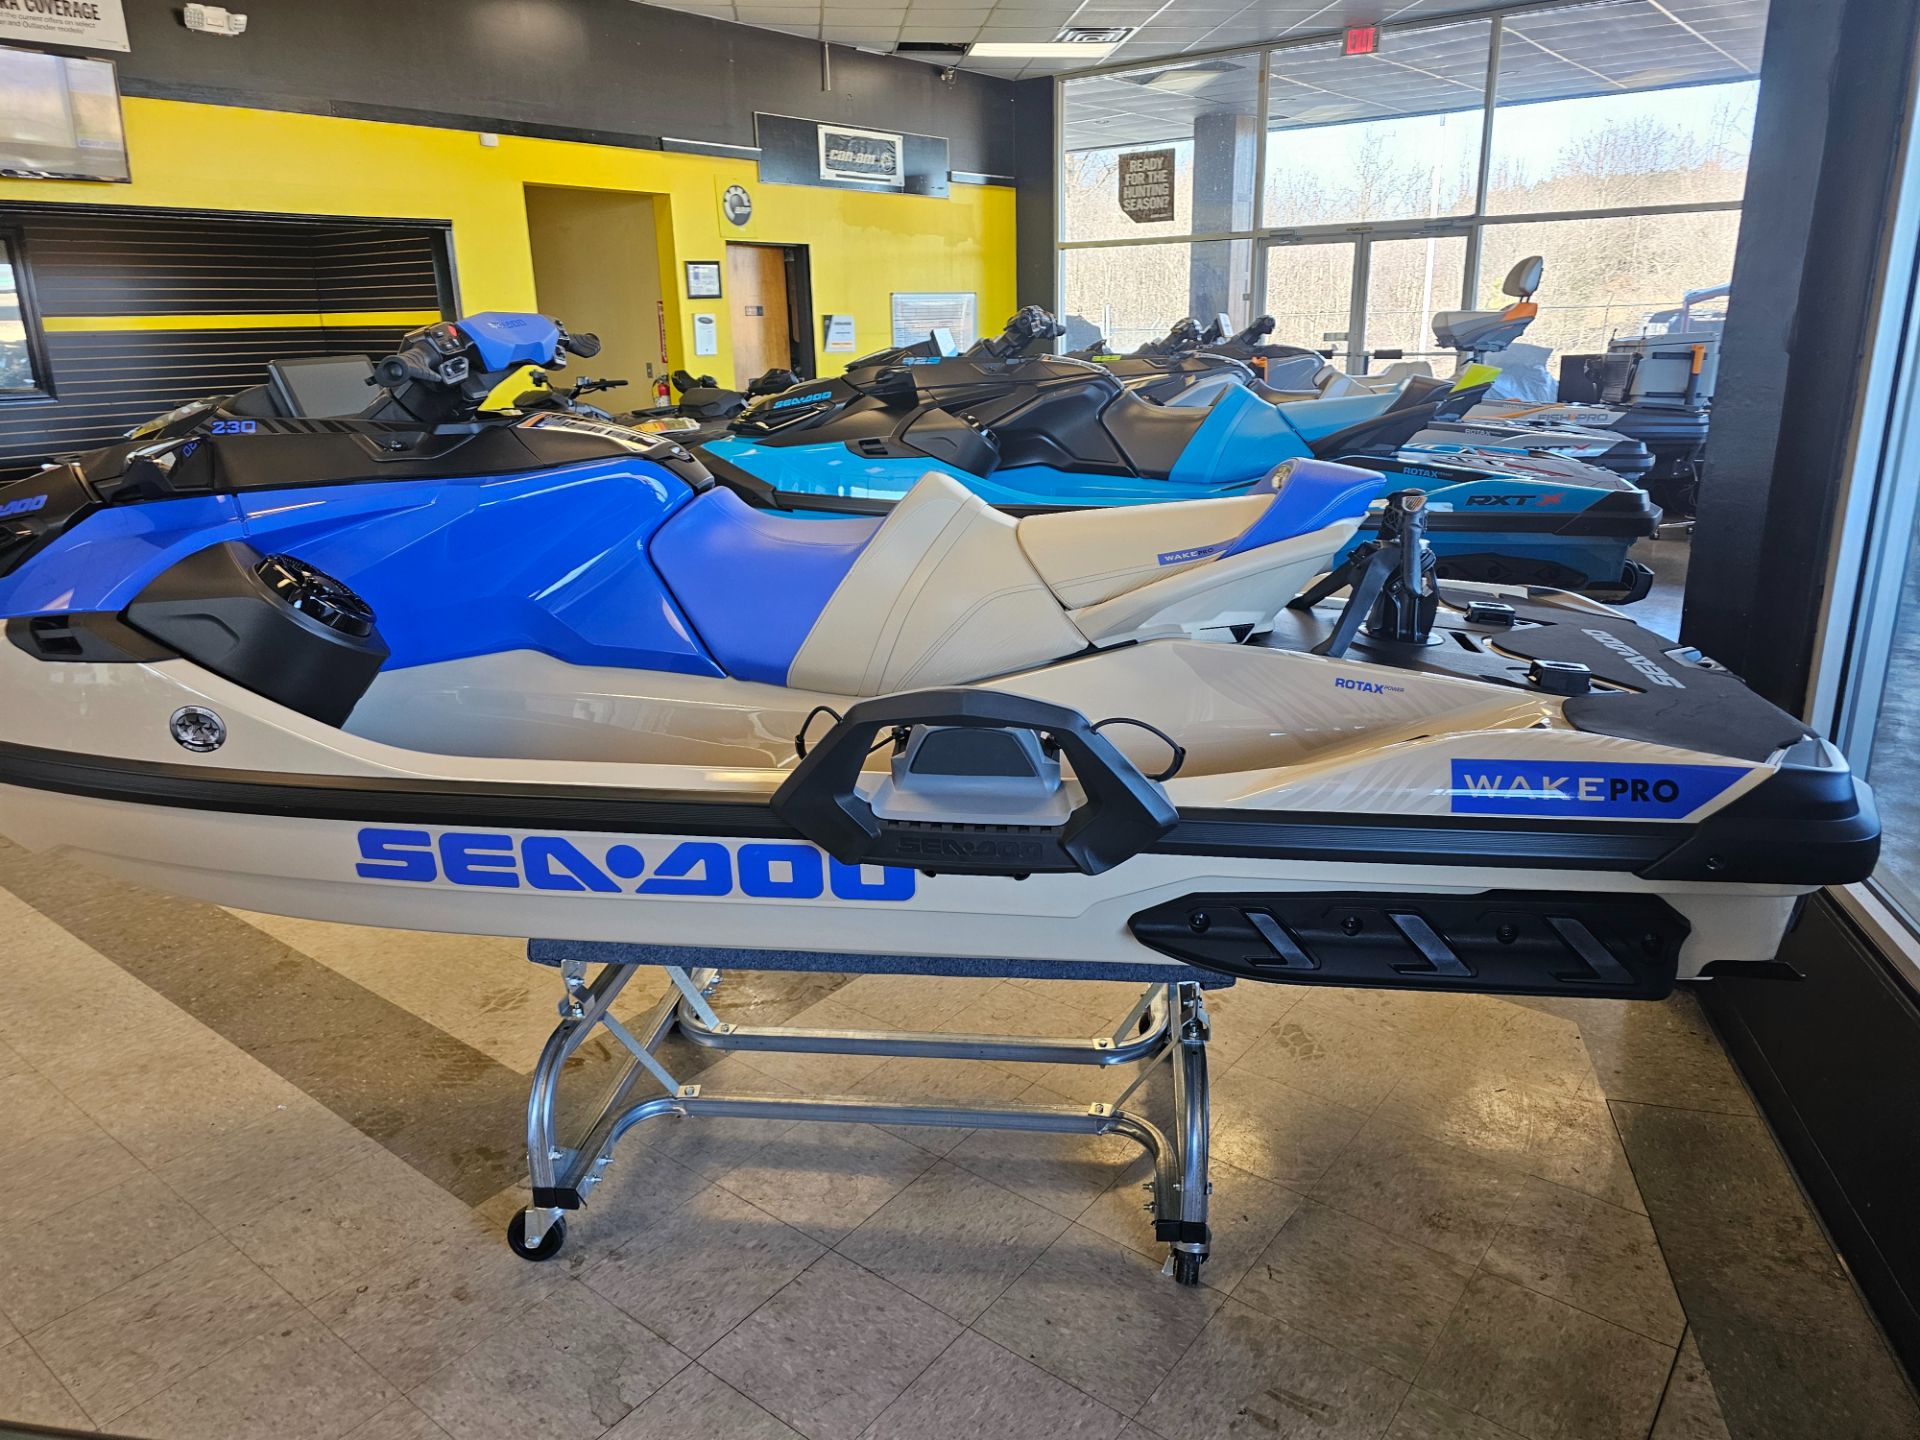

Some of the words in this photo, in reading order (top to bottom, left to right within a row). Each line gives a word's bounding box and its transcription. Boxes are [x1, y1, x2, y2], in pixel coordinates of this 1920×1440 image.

[25, 0, 101, 20] COVERAGE
[23, 21, 56, 31] Outlander
[44, 17, 63, 25] offers
[829, 150, 876, 165] can-am
[1129, 157, 1164, 172] READY
[1124, 172, 1145, 186] FOR
[1147, 170, 1168, 183] THE
[1123, 183, 1169, 199] HUNTING
[1123, 197, 1170, 211] SEASON?
[212, 420, 256, 434] 230
[1465, 428, 1491, 437] ROTAX
[1403, 466, 1438, 479] ROTAX
[1335, 677, 1384, 694] ROTAX
